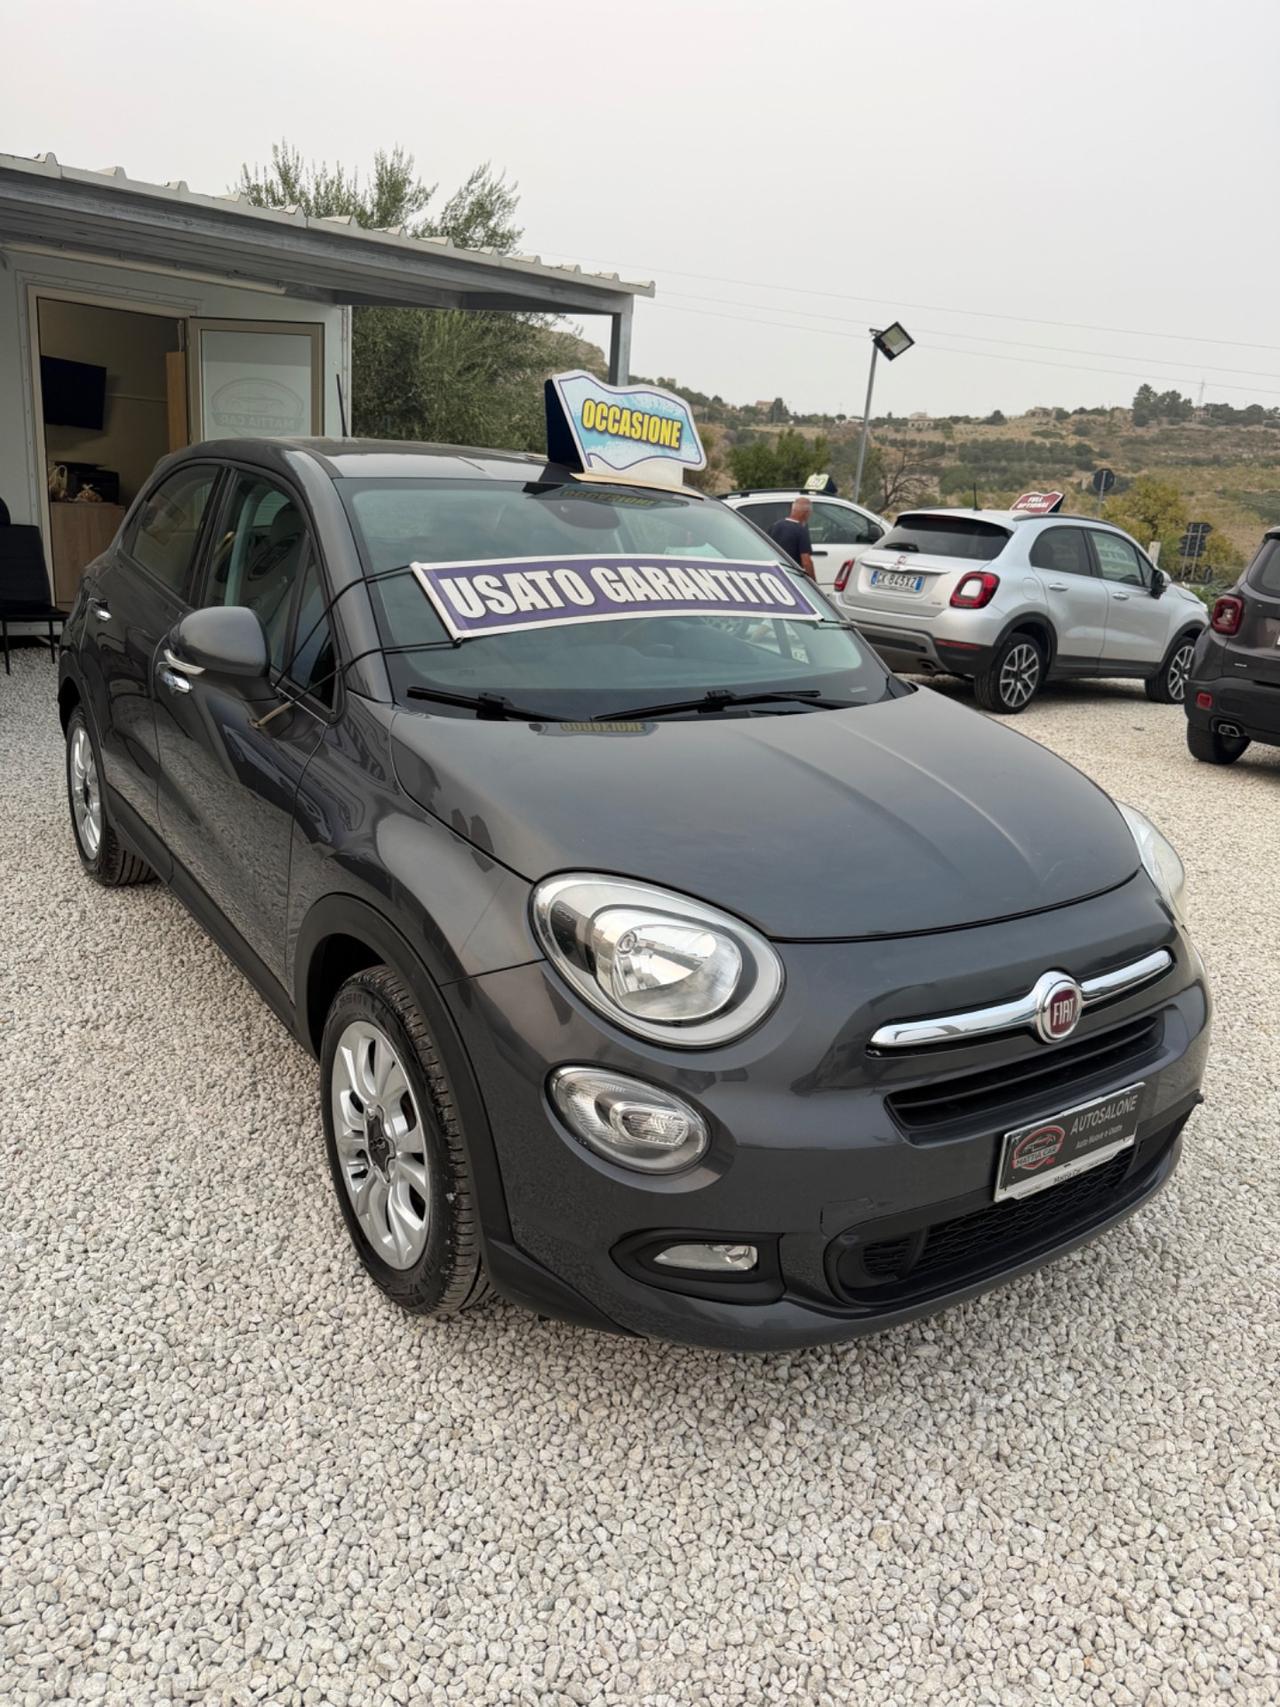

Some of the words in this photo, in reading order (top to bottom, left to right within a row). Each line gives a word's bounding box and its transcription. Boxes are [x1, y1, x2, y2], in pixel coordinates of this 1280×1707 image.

[581, 398, 682, 449] OCCASIONE
[438, 568, 595, 618] USATO
[590, 566, 796, 606] GARANTITO
[1053, 998, 1075, 1026] FIAT
[1070, 1094, 1138, 1135] AUTOSALONE
